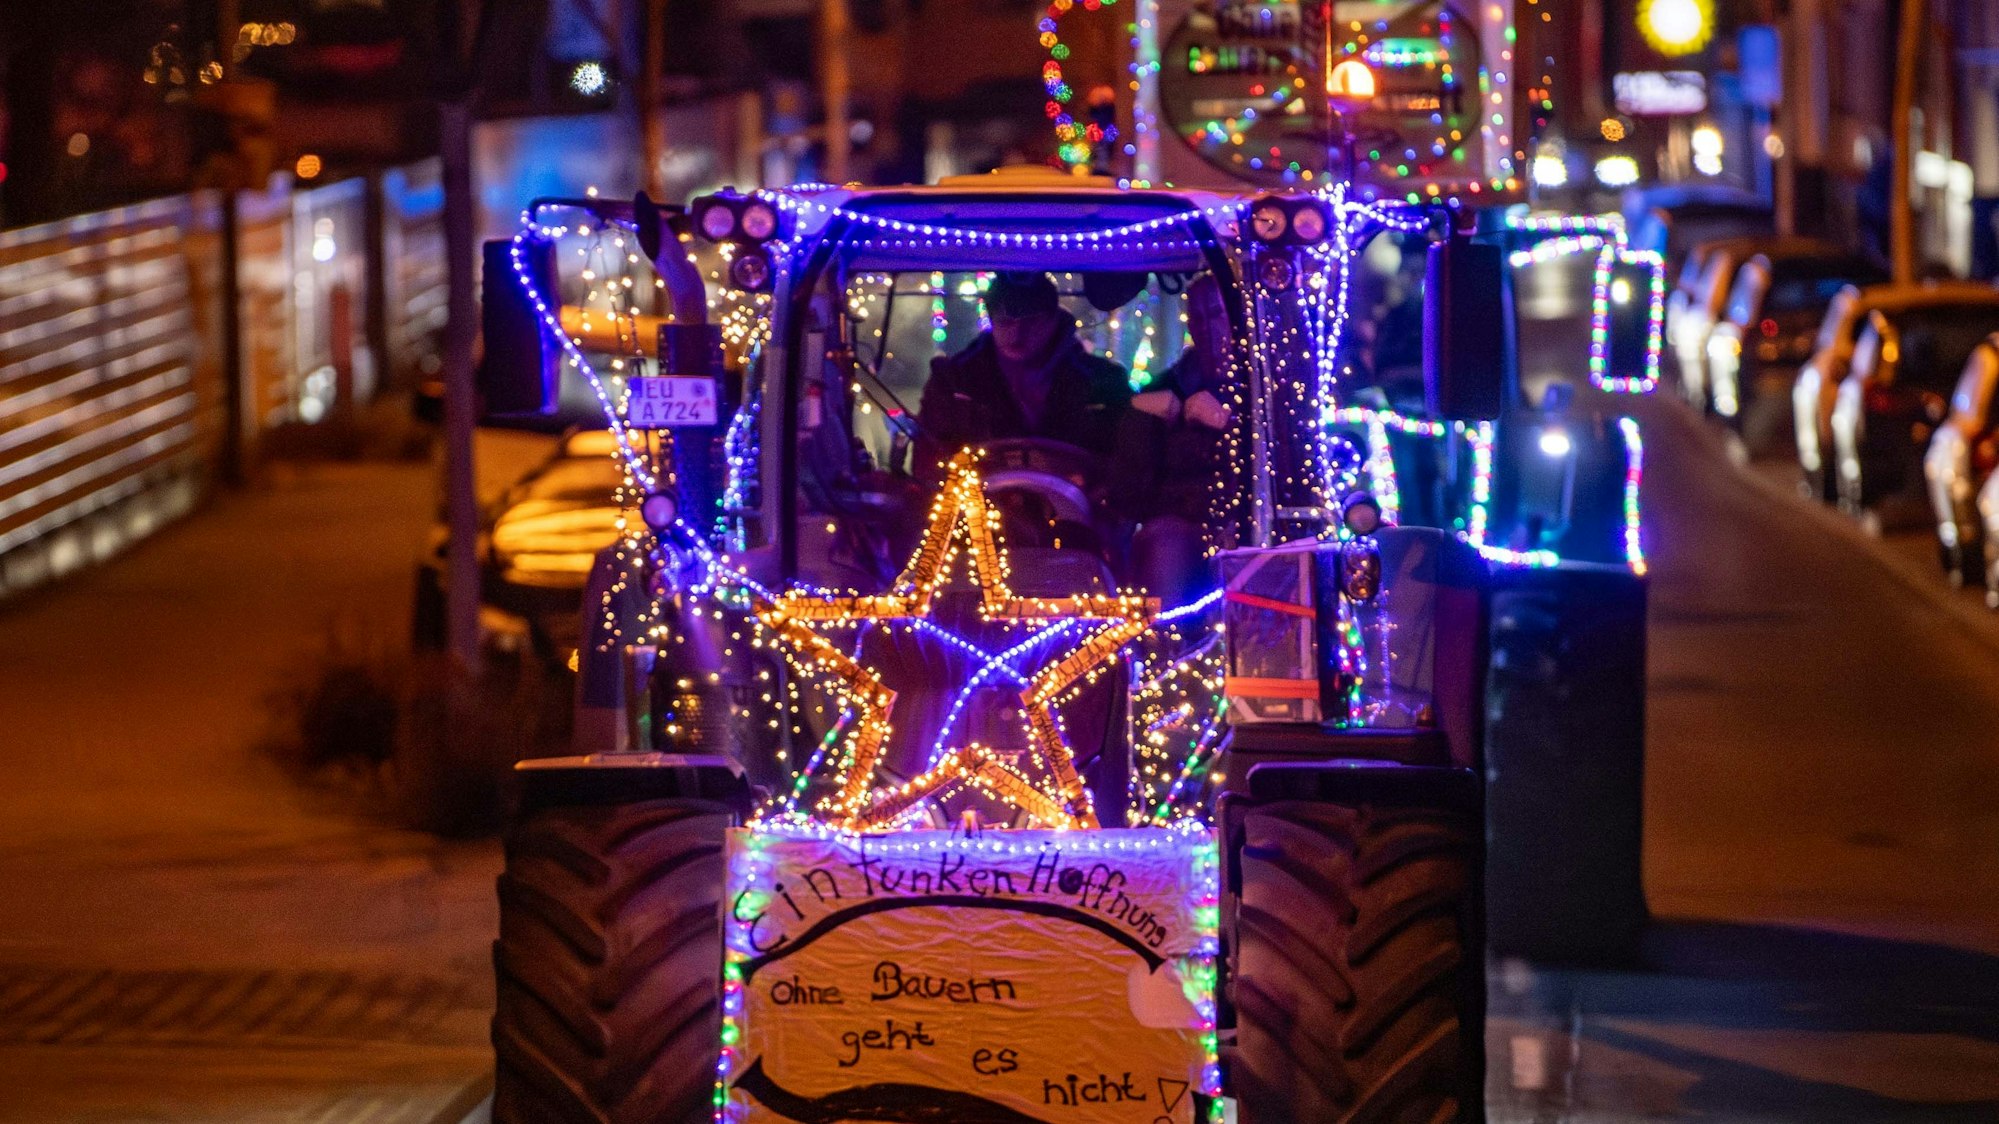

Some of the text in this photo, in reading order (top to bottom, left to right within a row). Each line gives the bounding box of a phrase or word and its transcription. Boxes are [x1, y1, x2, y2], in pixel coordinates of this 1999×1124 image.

[646, 380, 673, 399] EU
[642, 401, 700, 420] A 724
[733, 867, 842, 952] Ein
[1027, 841, 1167, 948] Hoffnung
[870, 961, 1016, 1003] Bauern
[838, 1020, 935, 1068] geht
[972, 1048, 1019, 1075] es
